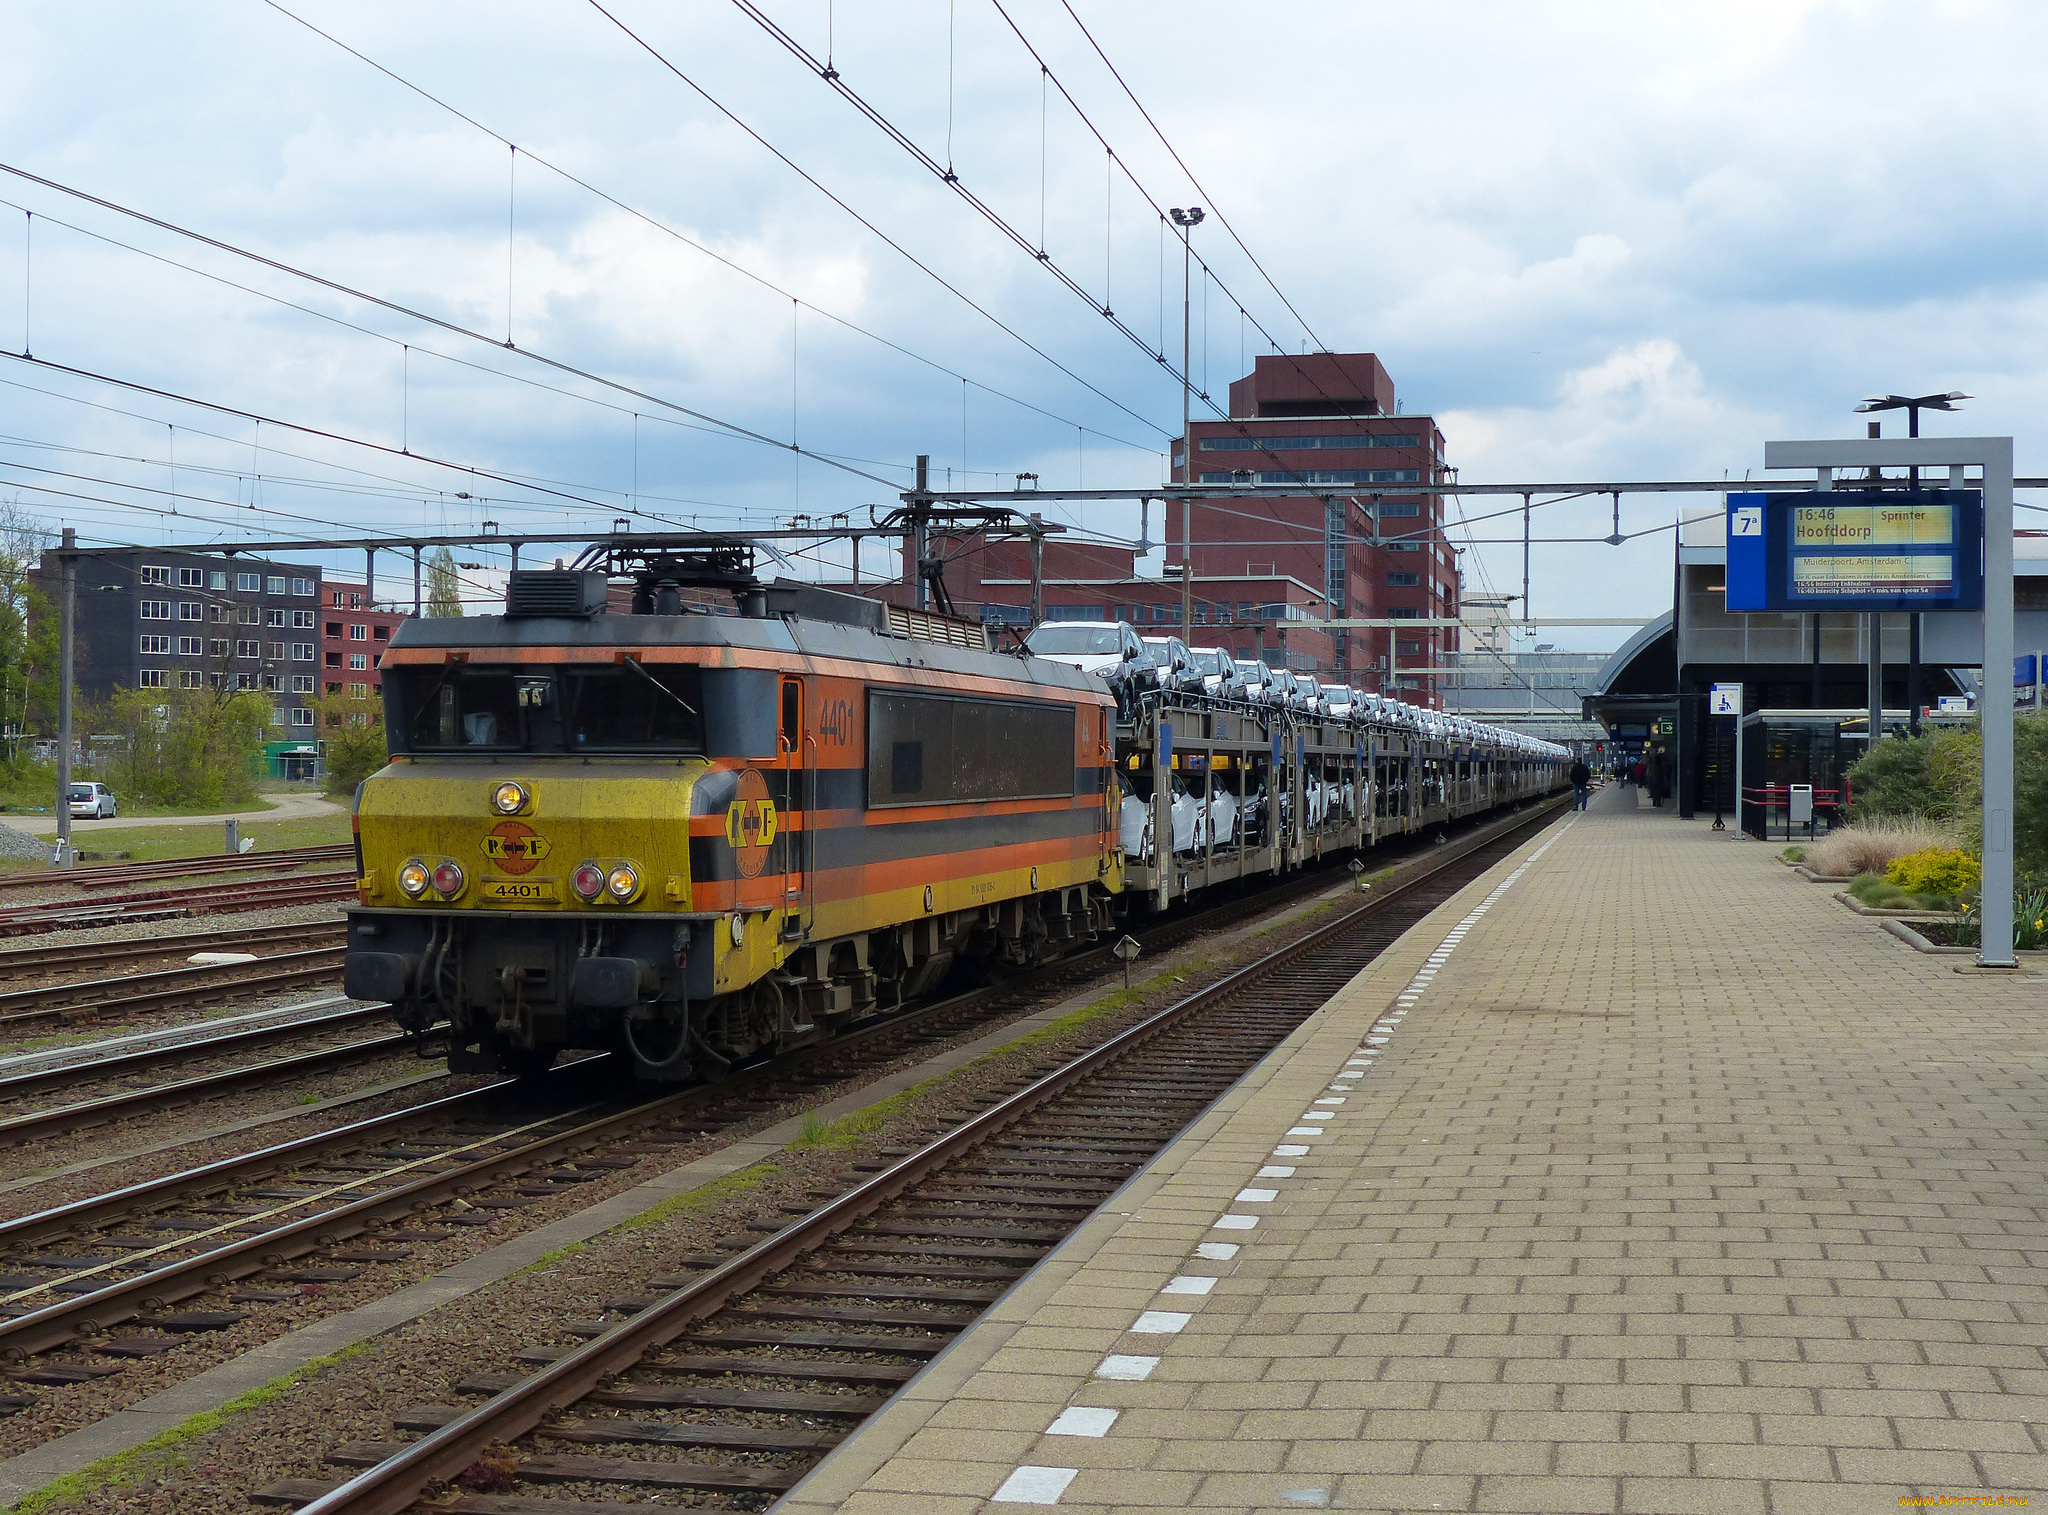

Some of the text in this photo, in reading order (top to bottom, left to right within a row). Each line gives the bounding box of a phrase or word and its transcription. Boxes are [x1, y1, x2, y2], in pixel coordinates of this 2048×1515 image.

[1797, 508, 1926, 522] 16:46 Sprinter
[1796, 524, 1872, 540] Hoofddorp
[1856, 557, 1901, 566] Amsterdam
[820, 699, 853, 746] 4401
[495, 885, 541, 897] 4401
